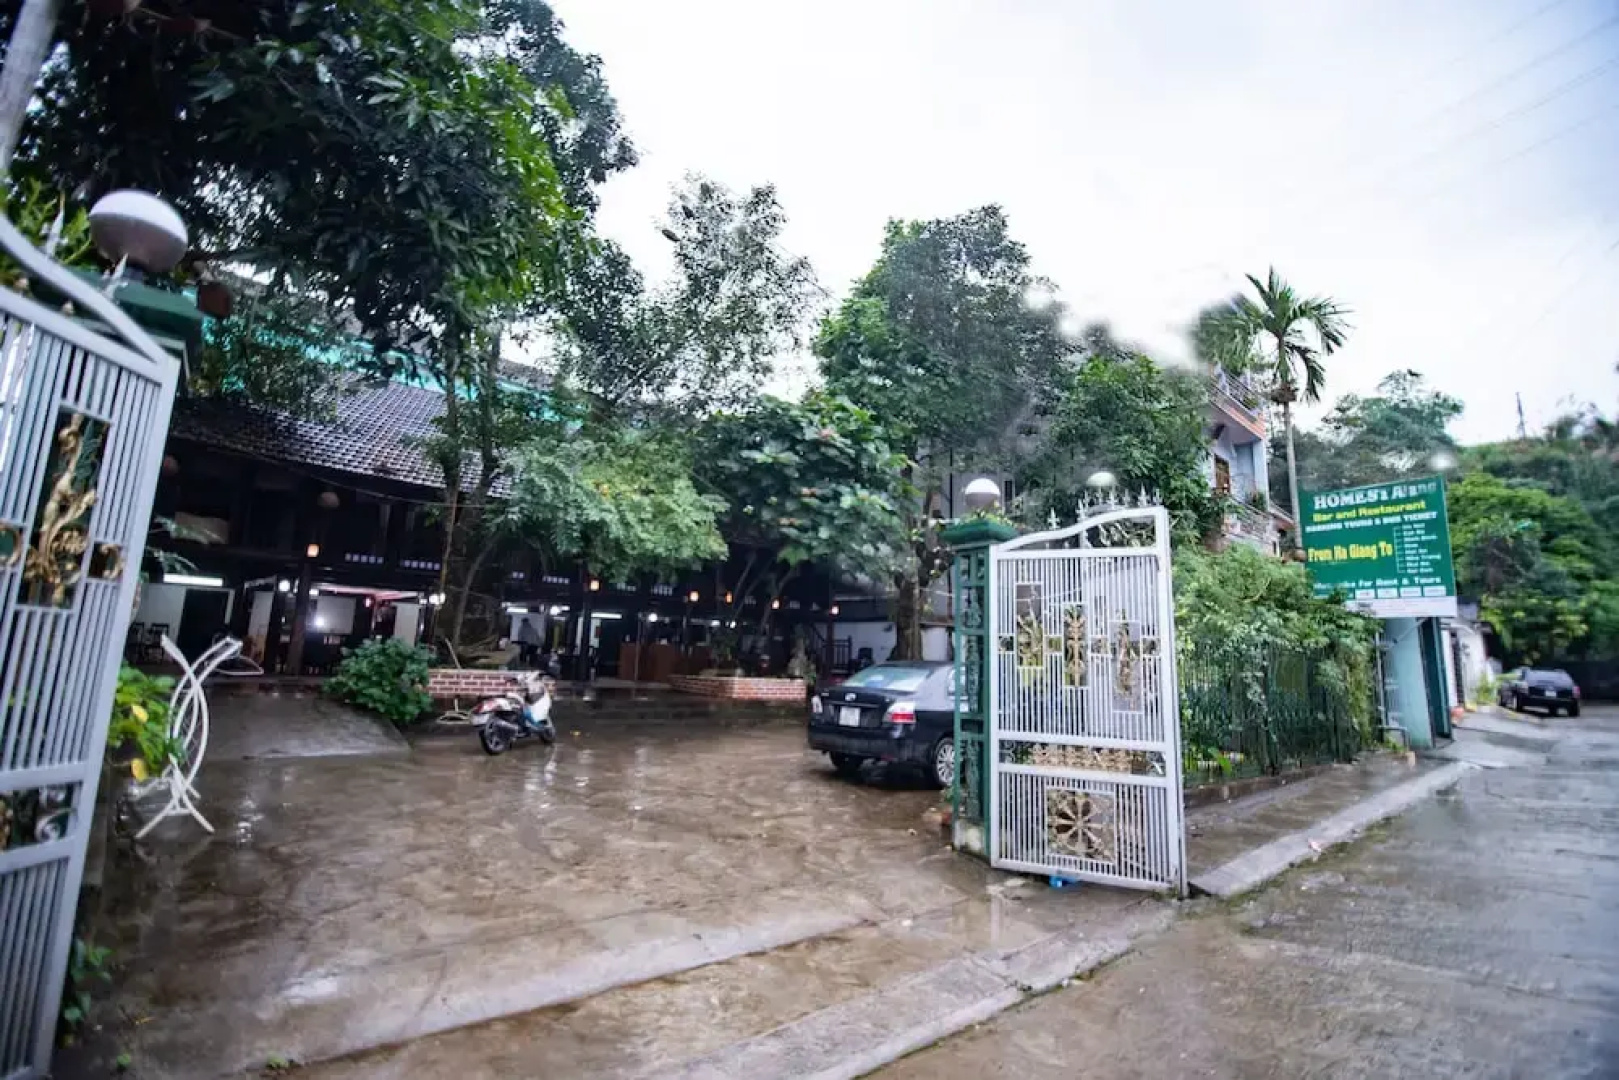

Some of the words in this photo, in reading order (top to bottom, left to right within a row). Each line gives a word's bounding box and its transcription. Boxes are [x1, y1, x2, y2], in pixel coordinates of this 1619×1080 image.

[1335, 508, 1356, 519] and
[1358, 500, 1426, 516] Restaurant
[1307, 548, 1332, 562] From
[1349, 543, 1377, 560] Giang
[1378, 540, 1393, 557] To
